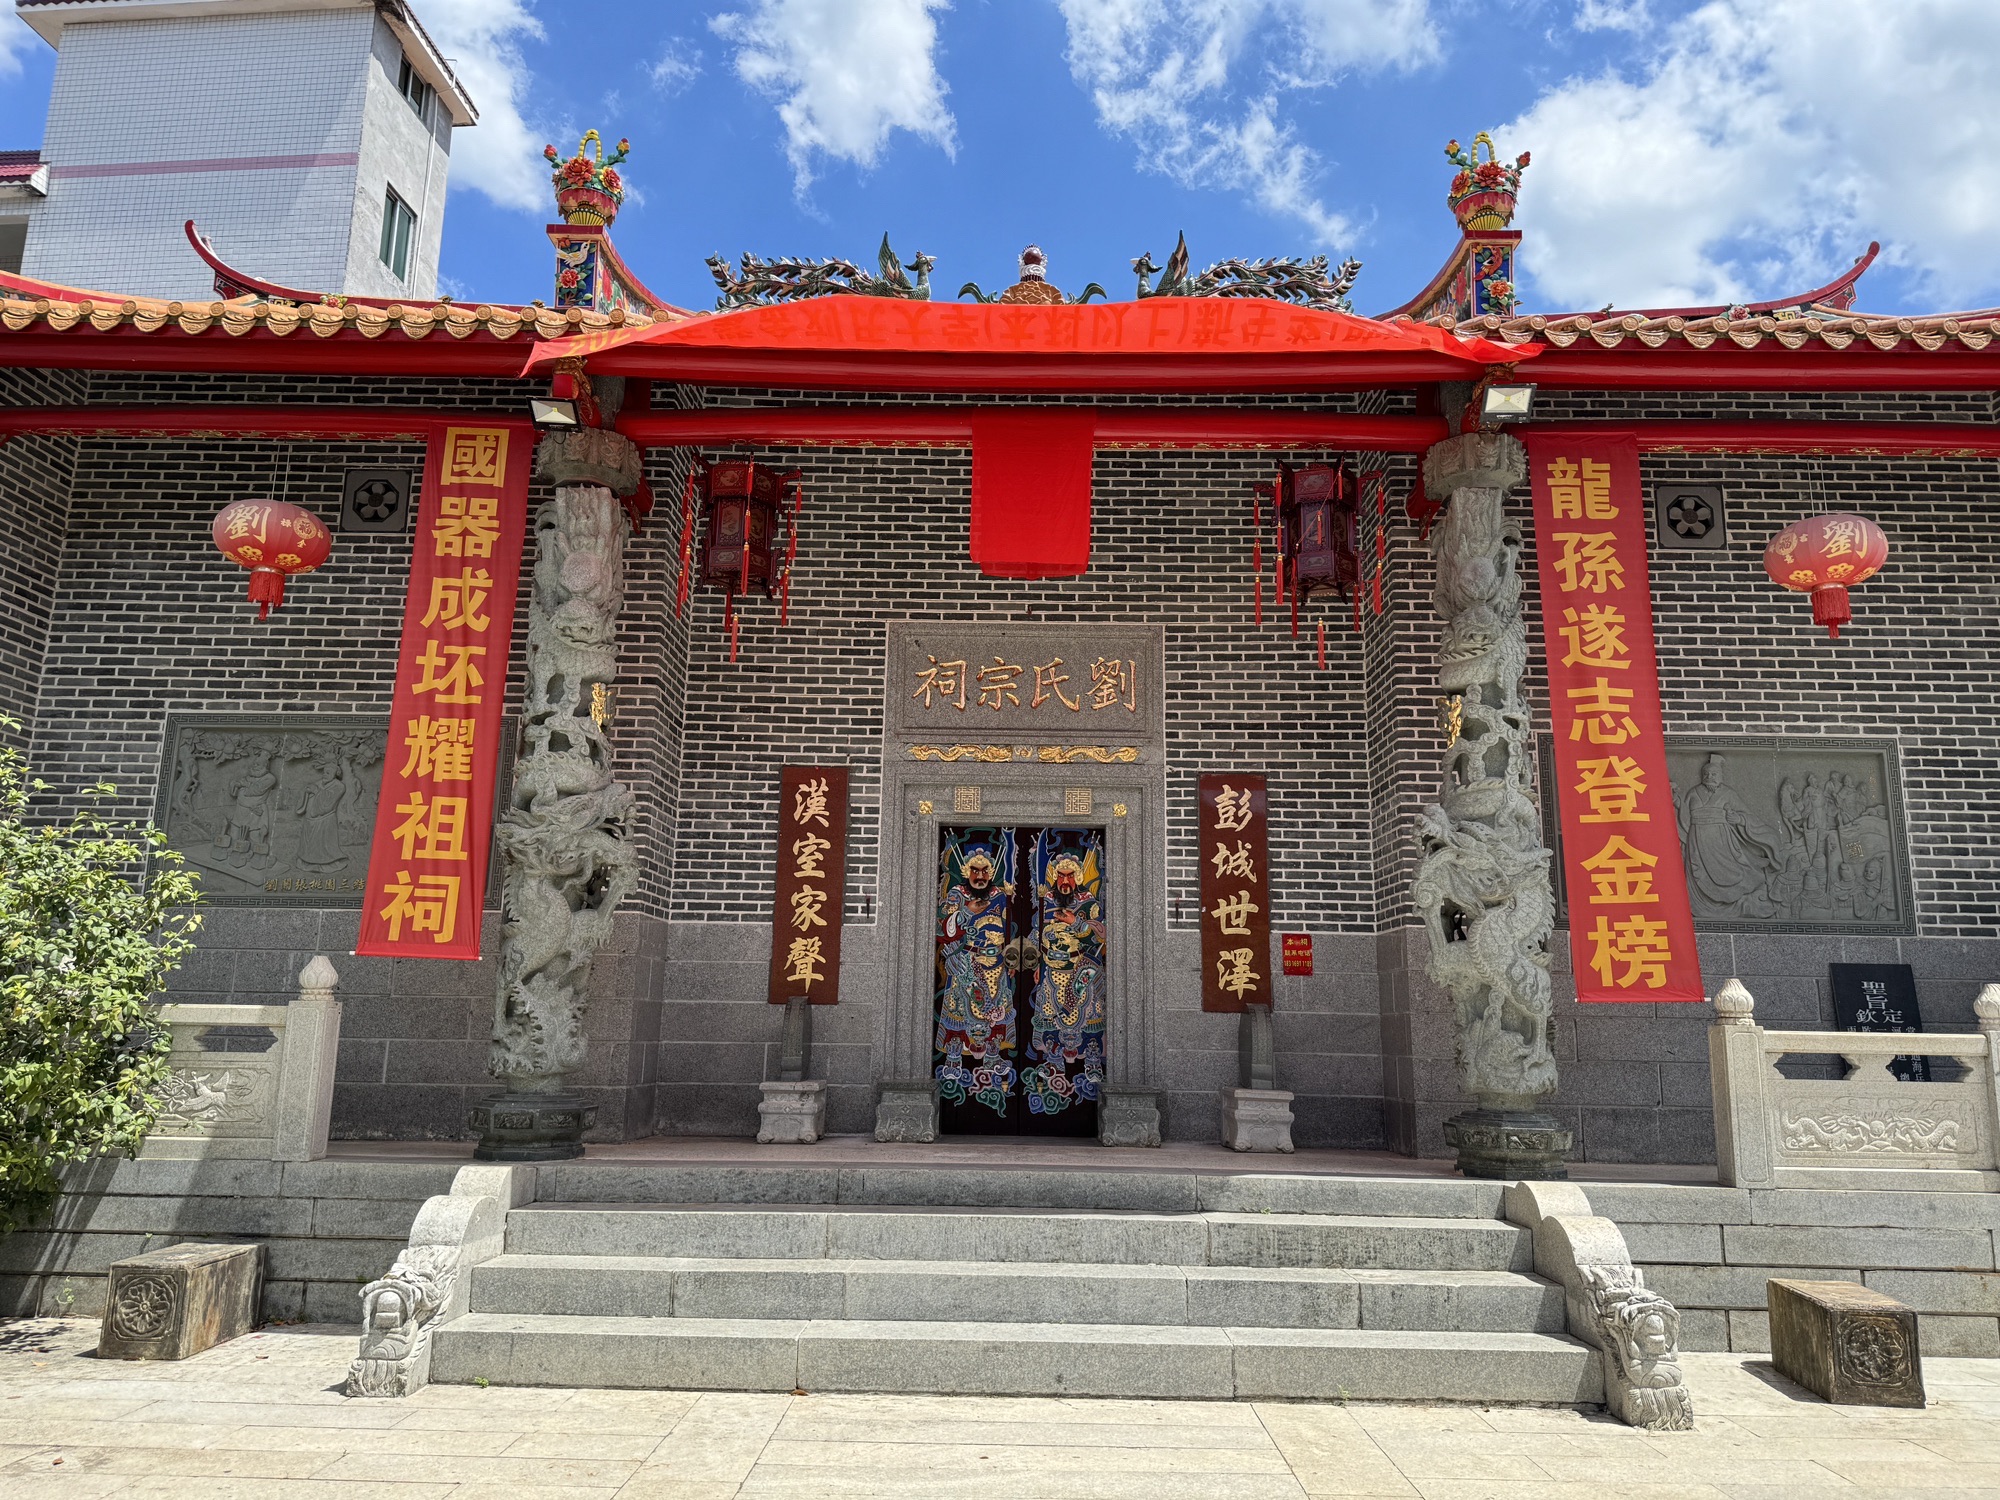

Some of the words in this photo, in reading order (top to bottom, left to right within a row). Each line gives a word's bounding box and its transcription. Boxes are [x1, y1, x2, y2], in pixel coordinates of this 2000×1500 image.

[225, 504, 272, 544] 劉
[1819, 520, 1868, 559] 劉
[380, 427, 509, 943] 國器成坯耀祖祠
[912, 654, 1137, 712] 劉氏宗祠
[1547, 457, 1672, 988] 龍孫遂志登金榜
[784, 777, 832, 994] 漢室家聲
[1211, 784, 1261, 1000] 彭城世澤
[1855, 1009, 1904, 1024] 欽定
[1861, 981, 1889, 1010] 聖旨
